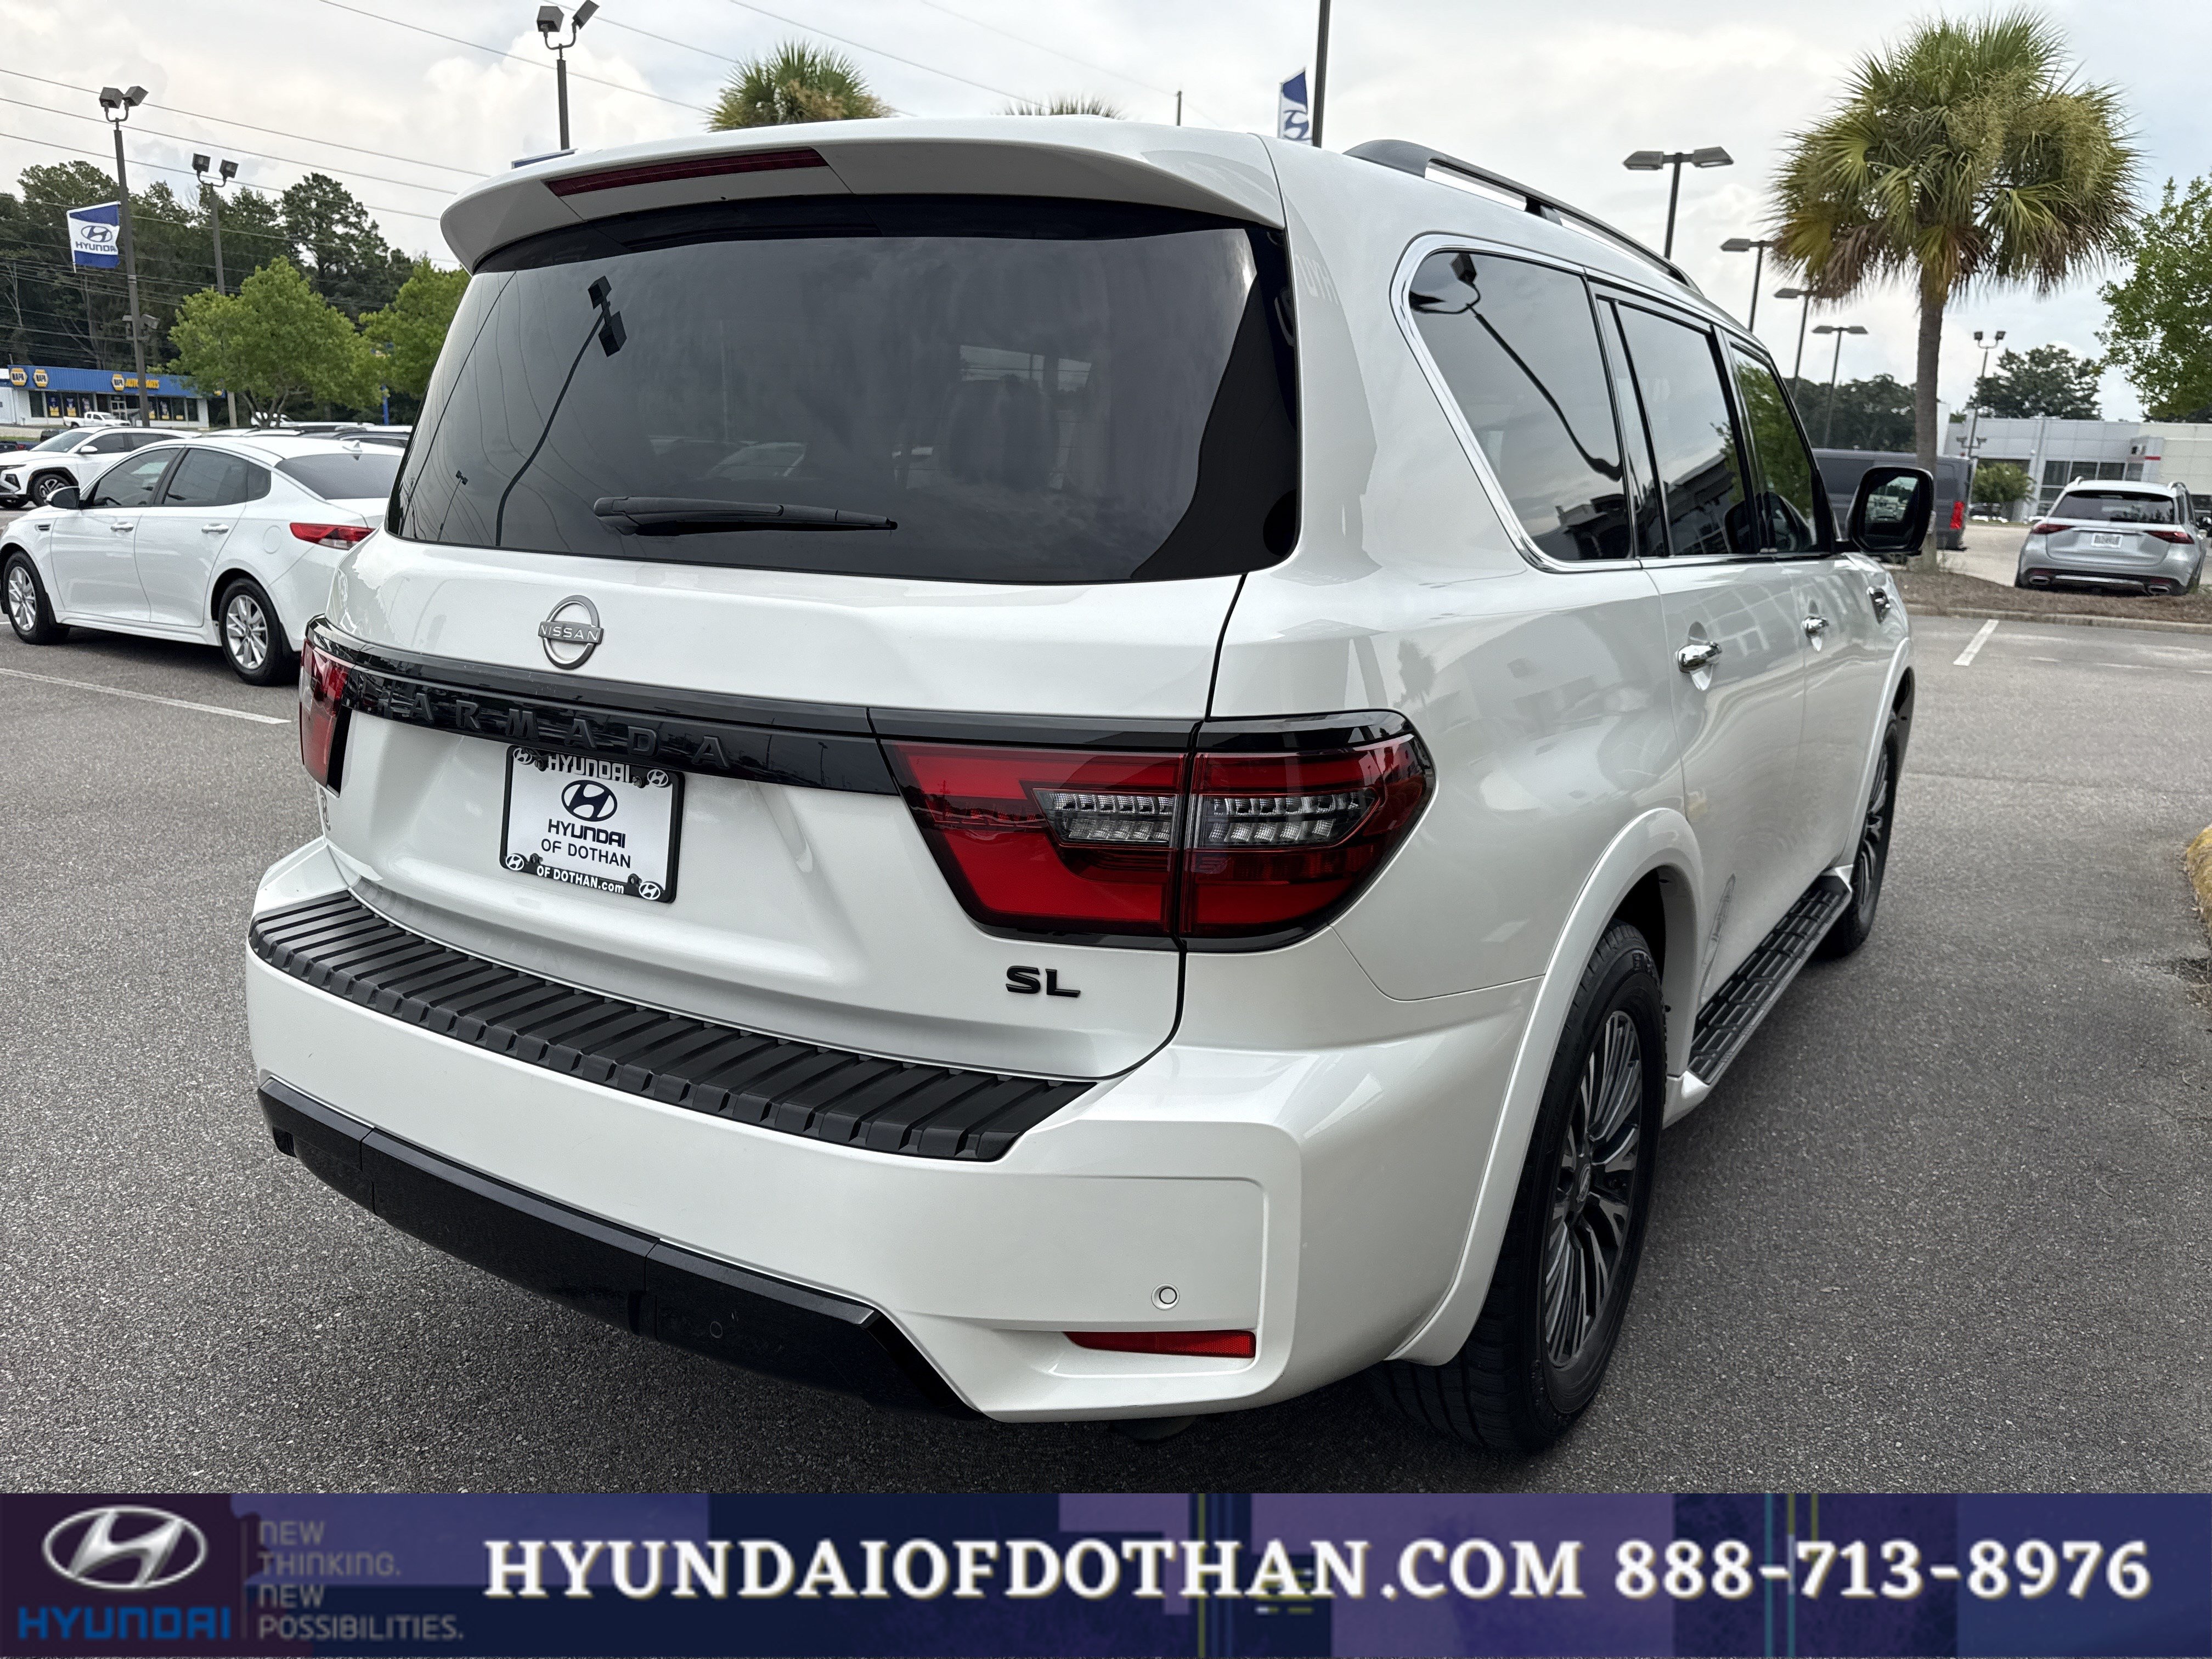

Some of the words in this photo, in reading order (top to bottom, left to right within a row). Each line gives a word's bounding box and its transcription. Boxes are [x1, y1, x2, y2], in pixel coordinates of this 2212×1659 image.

[76, 241, 117, 252] HYUNDA
[539, 625, 599, 641] NISSAN
[408, 692, 730, 769] ARMADA
[548, 754, 630, 783] HYUNDAI
[548, 819, 626, 848] HYUNDAI
[541, 839, 562, 854] OF
[568, 843, 631, 868] DOTHAN
[537, 865, 551, 878] OF
[553, 868, 624, 894] DOTHAN.com
[1005, 965, 1081, 998] SL
